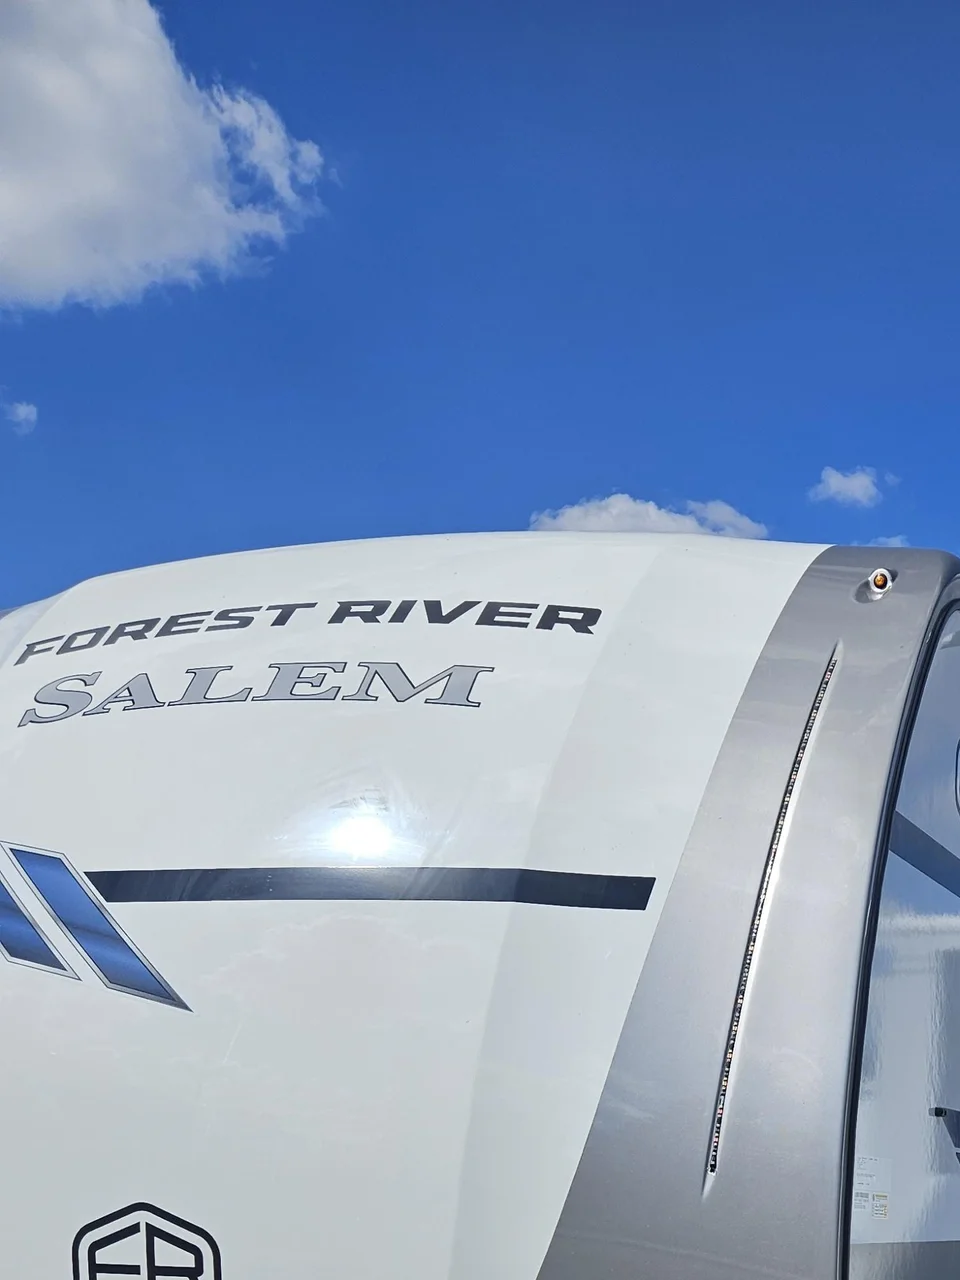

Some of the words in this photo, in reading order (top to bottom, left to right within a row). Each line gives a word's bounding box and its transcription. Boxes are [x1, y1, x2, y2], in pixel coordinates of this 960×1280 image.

[13, 602, 318, 666] FOREST
[327, 600, 602, 635] RIVER
[18, 661, 495, 727] SALEM
